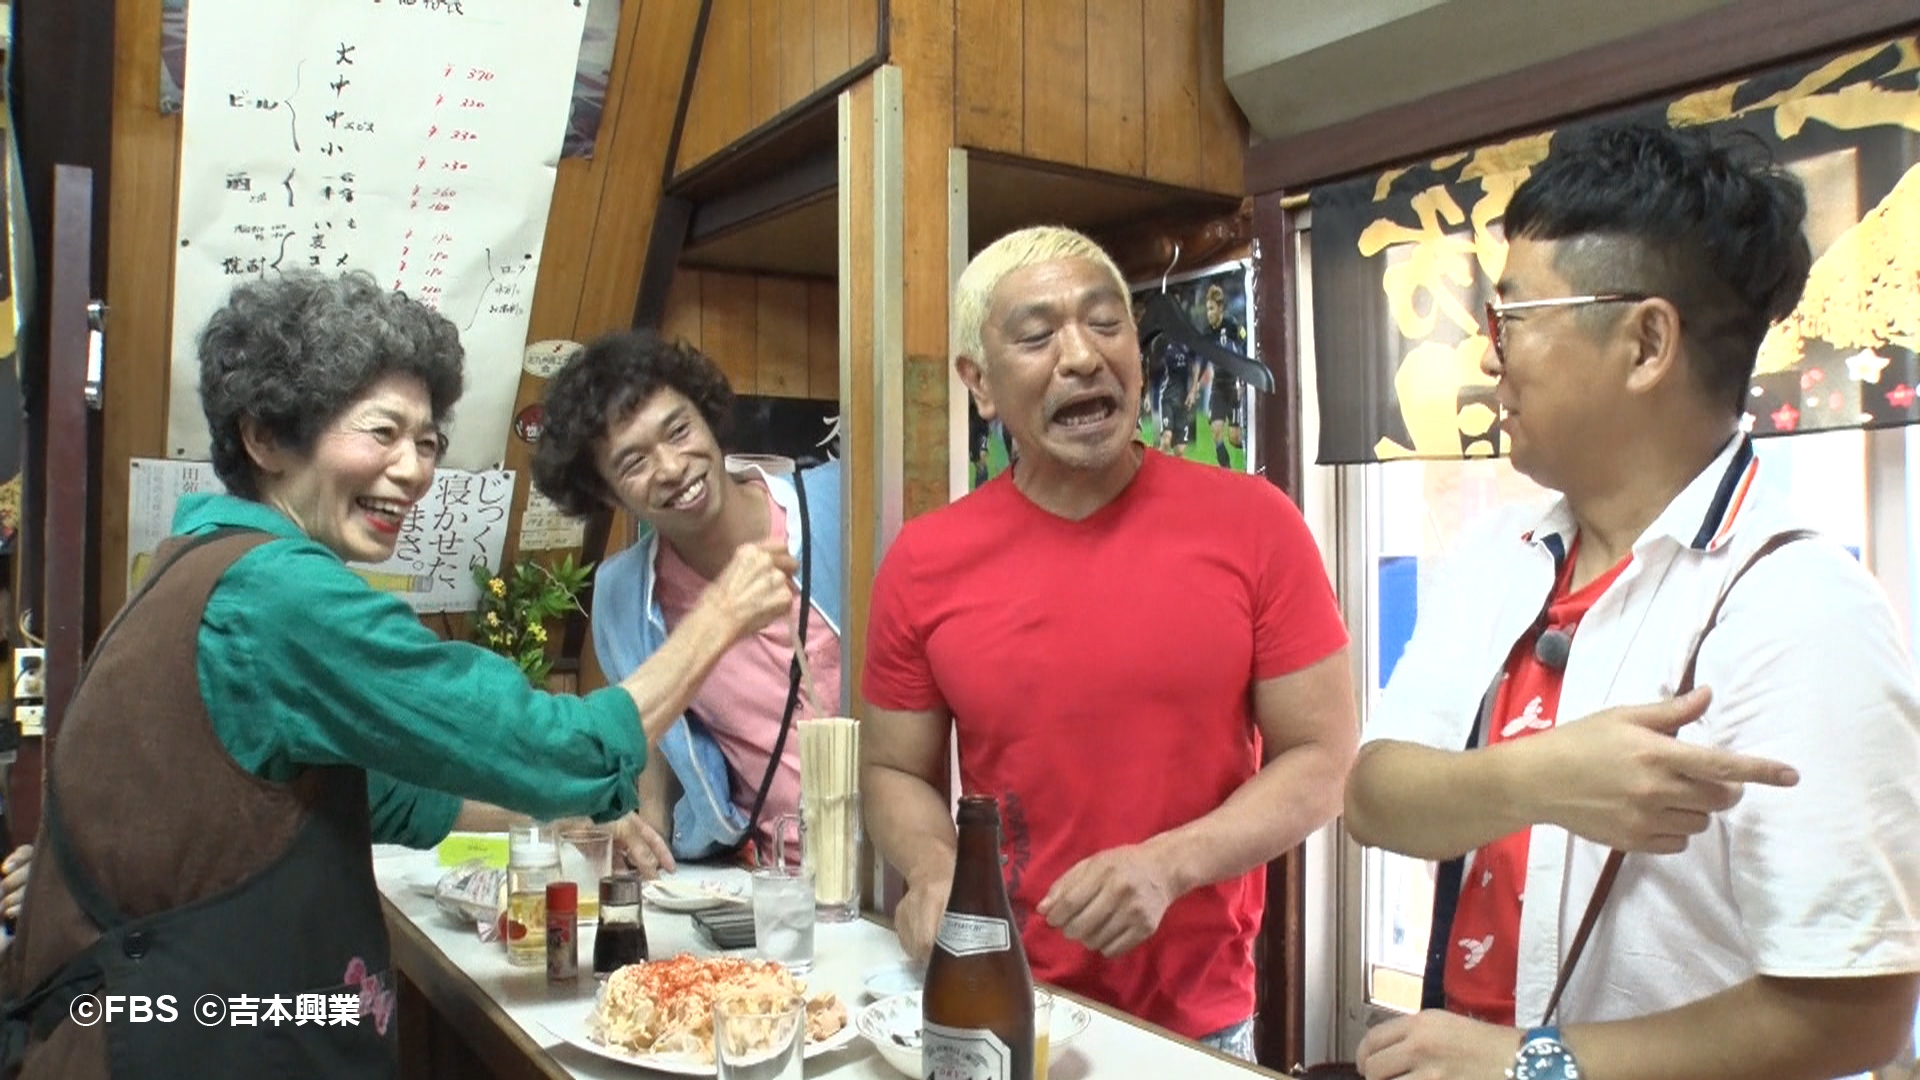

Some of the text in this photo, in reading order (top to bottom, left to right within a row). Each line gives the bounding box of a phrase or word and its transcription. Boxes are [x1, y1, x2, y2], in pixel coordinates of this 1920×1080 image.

[336, 42, 355, 65] 大
[467, 68, 494, 81] 370
[330, 74, 350, 98] 中
[229, 89, 278, 110] ビール
[325, 110, 344, 129] 中
[320, 141, 343, 156] 小
